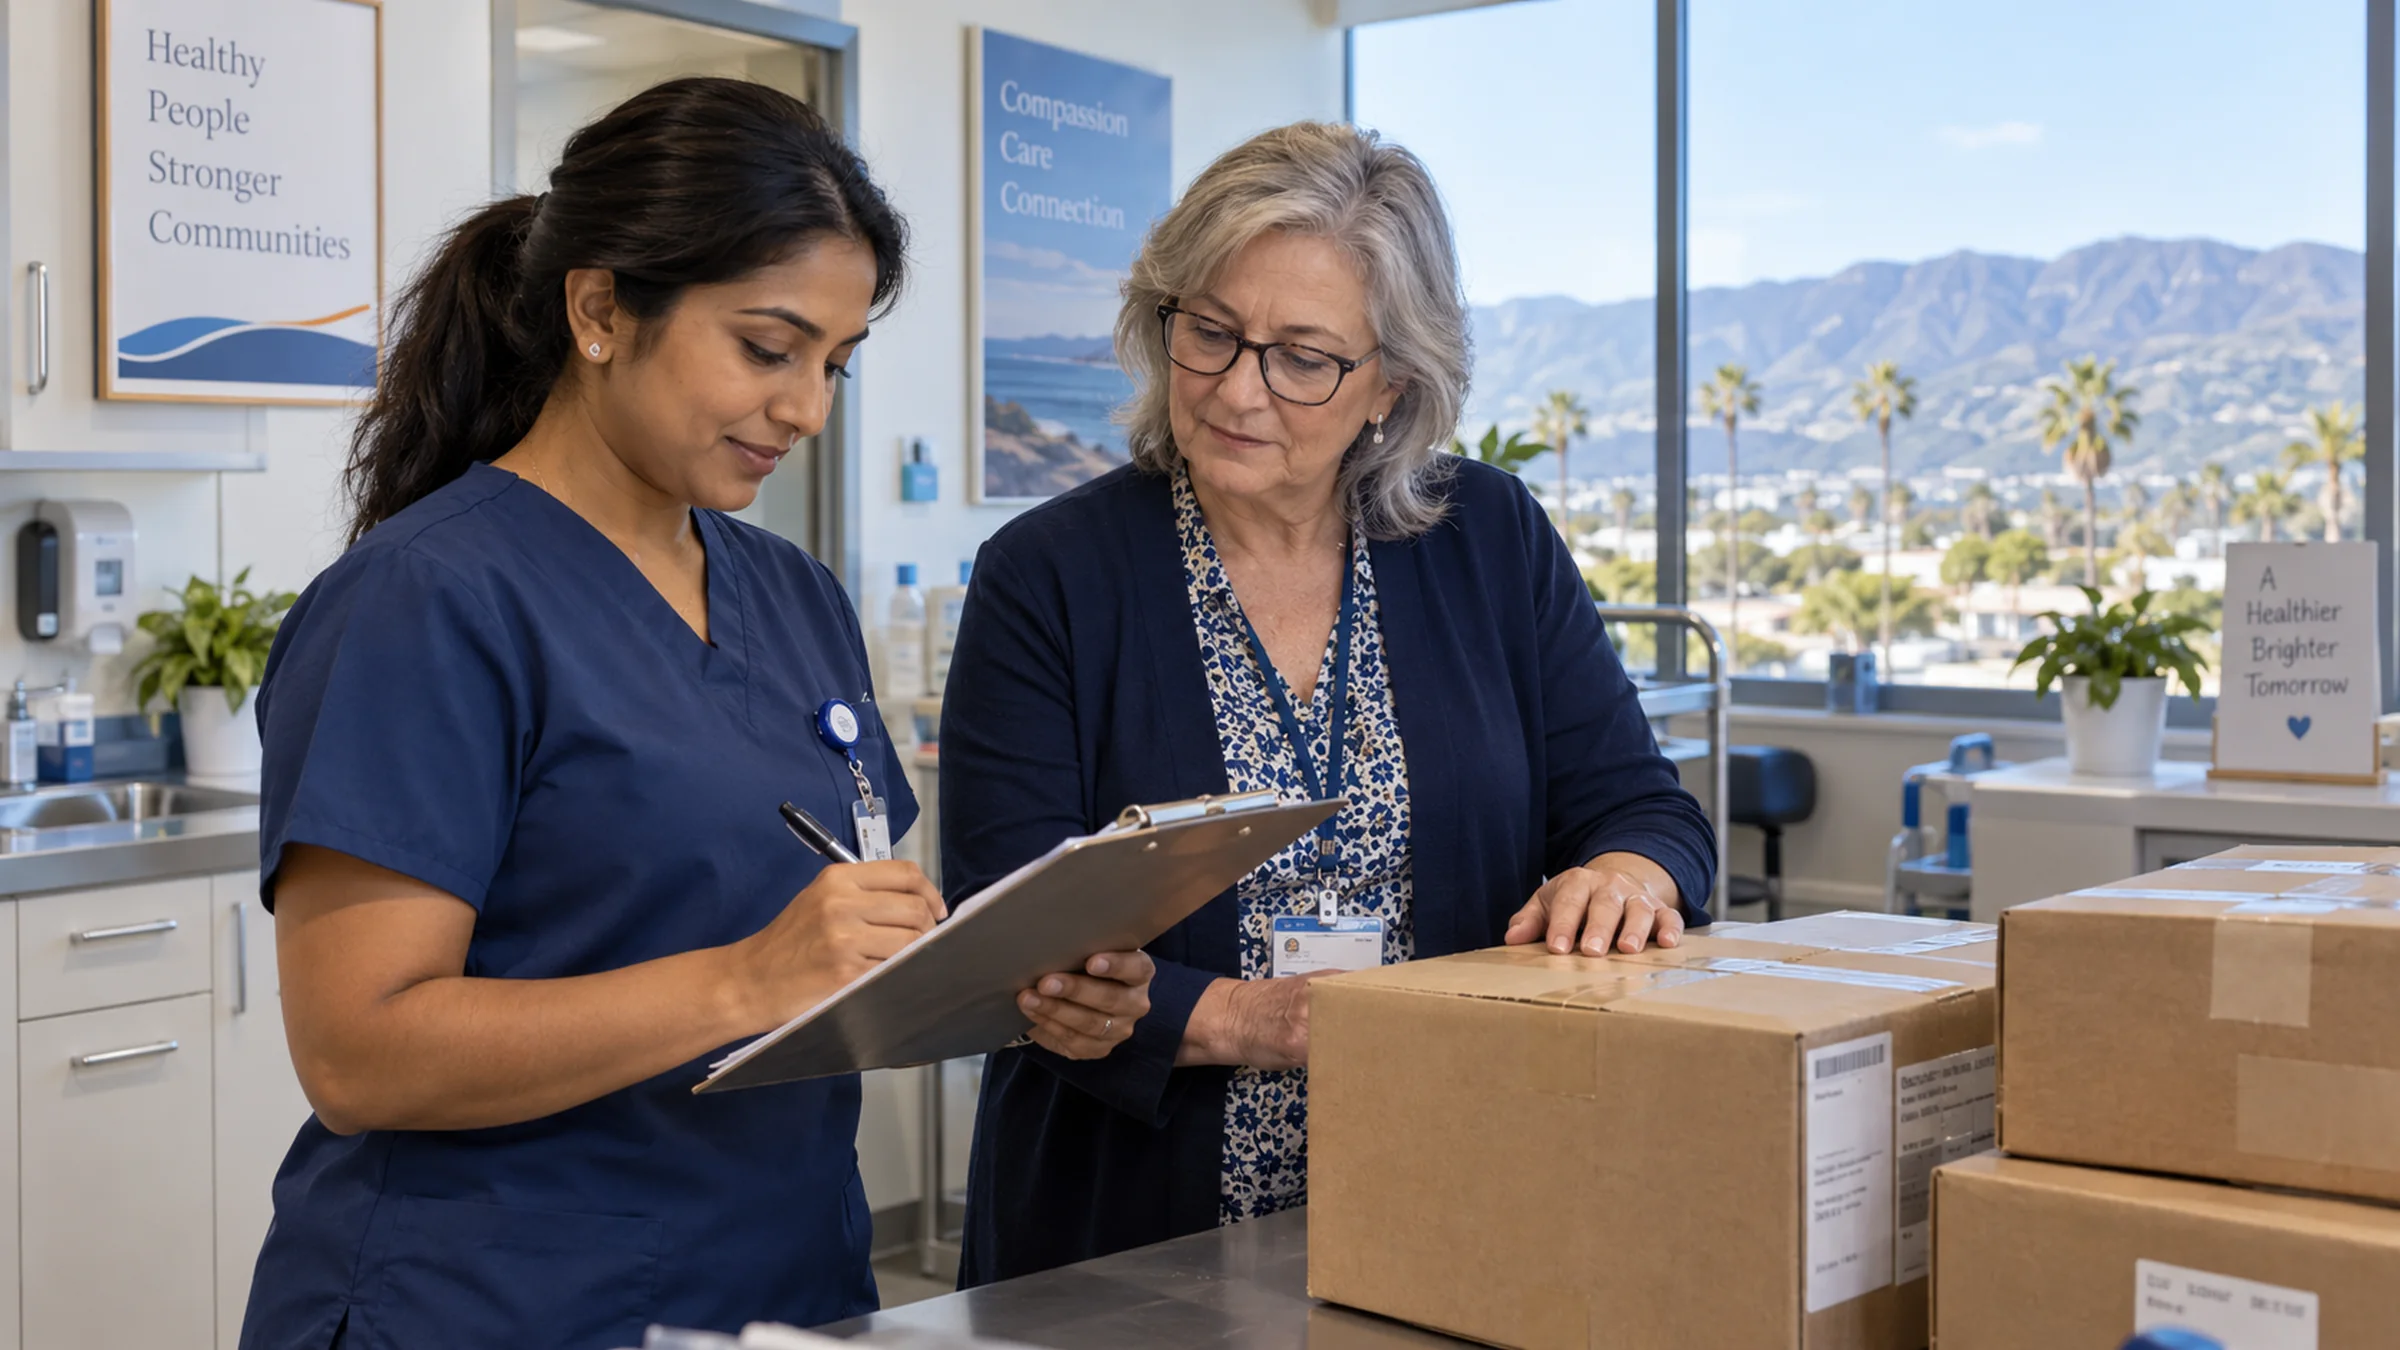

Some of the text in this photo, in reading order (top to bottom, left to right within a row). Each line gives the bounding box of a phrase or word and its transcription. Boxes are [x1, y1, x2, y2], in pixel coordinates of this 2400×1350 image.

[147, 28, 266, 88] Healthy
[147, 89, 250, 140] People
[1000, 80, 1129, 138] Compassion
[1000, 130, 1053, 170] Care
[148, 150, 282, 203] Stronger
[1000, 181, 1125, 230] Connection
[148, 209, 351, 260] Communities
[2259, 565, 2277, 592] A
[2246, 598, 2341, 625] Healthier
[2251, 637, 2339, 668] Brighter
[2244, 672, 2349, 697] Tomorrow
